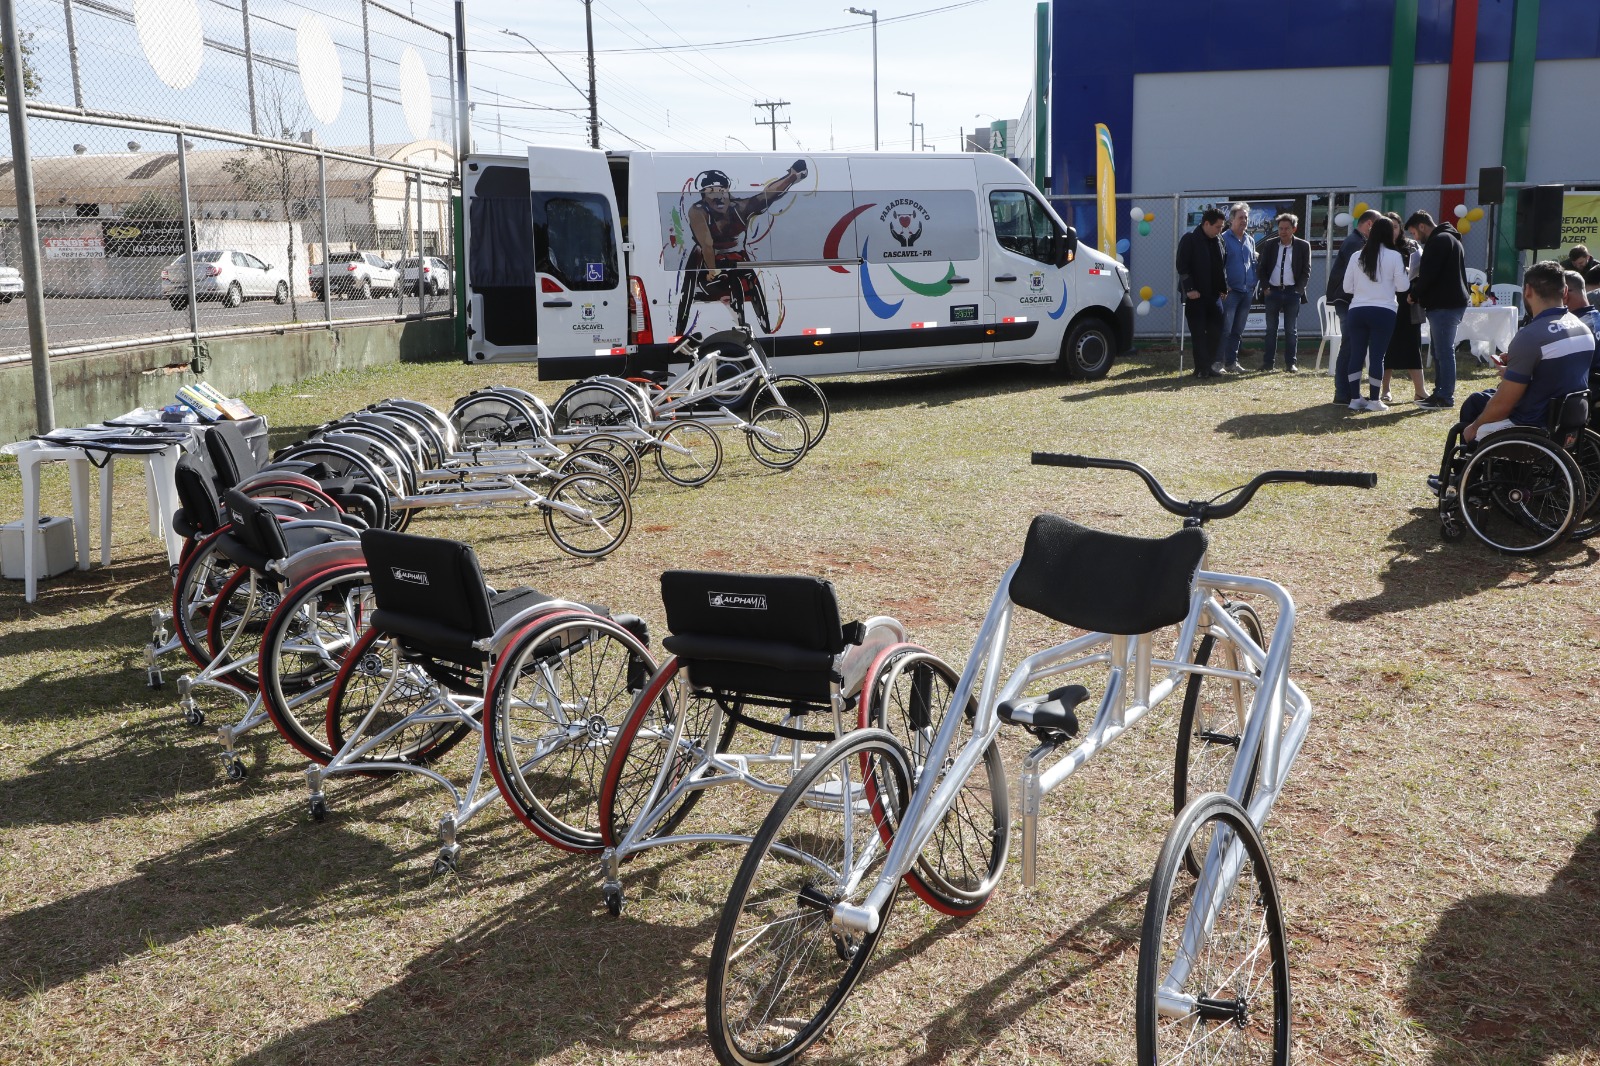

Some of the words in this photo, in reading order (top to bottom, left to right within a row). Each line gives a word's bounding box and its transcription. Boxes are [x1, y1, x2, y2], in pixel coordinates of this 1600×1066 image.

[880, 199, 931, 222] PARADESPORTO
[1019, 295, 1054, 304] CASCAVEL
[572, 323, 604, 331] CASCAVEL
[723, 596, 766, 608] ALPHAMIX
